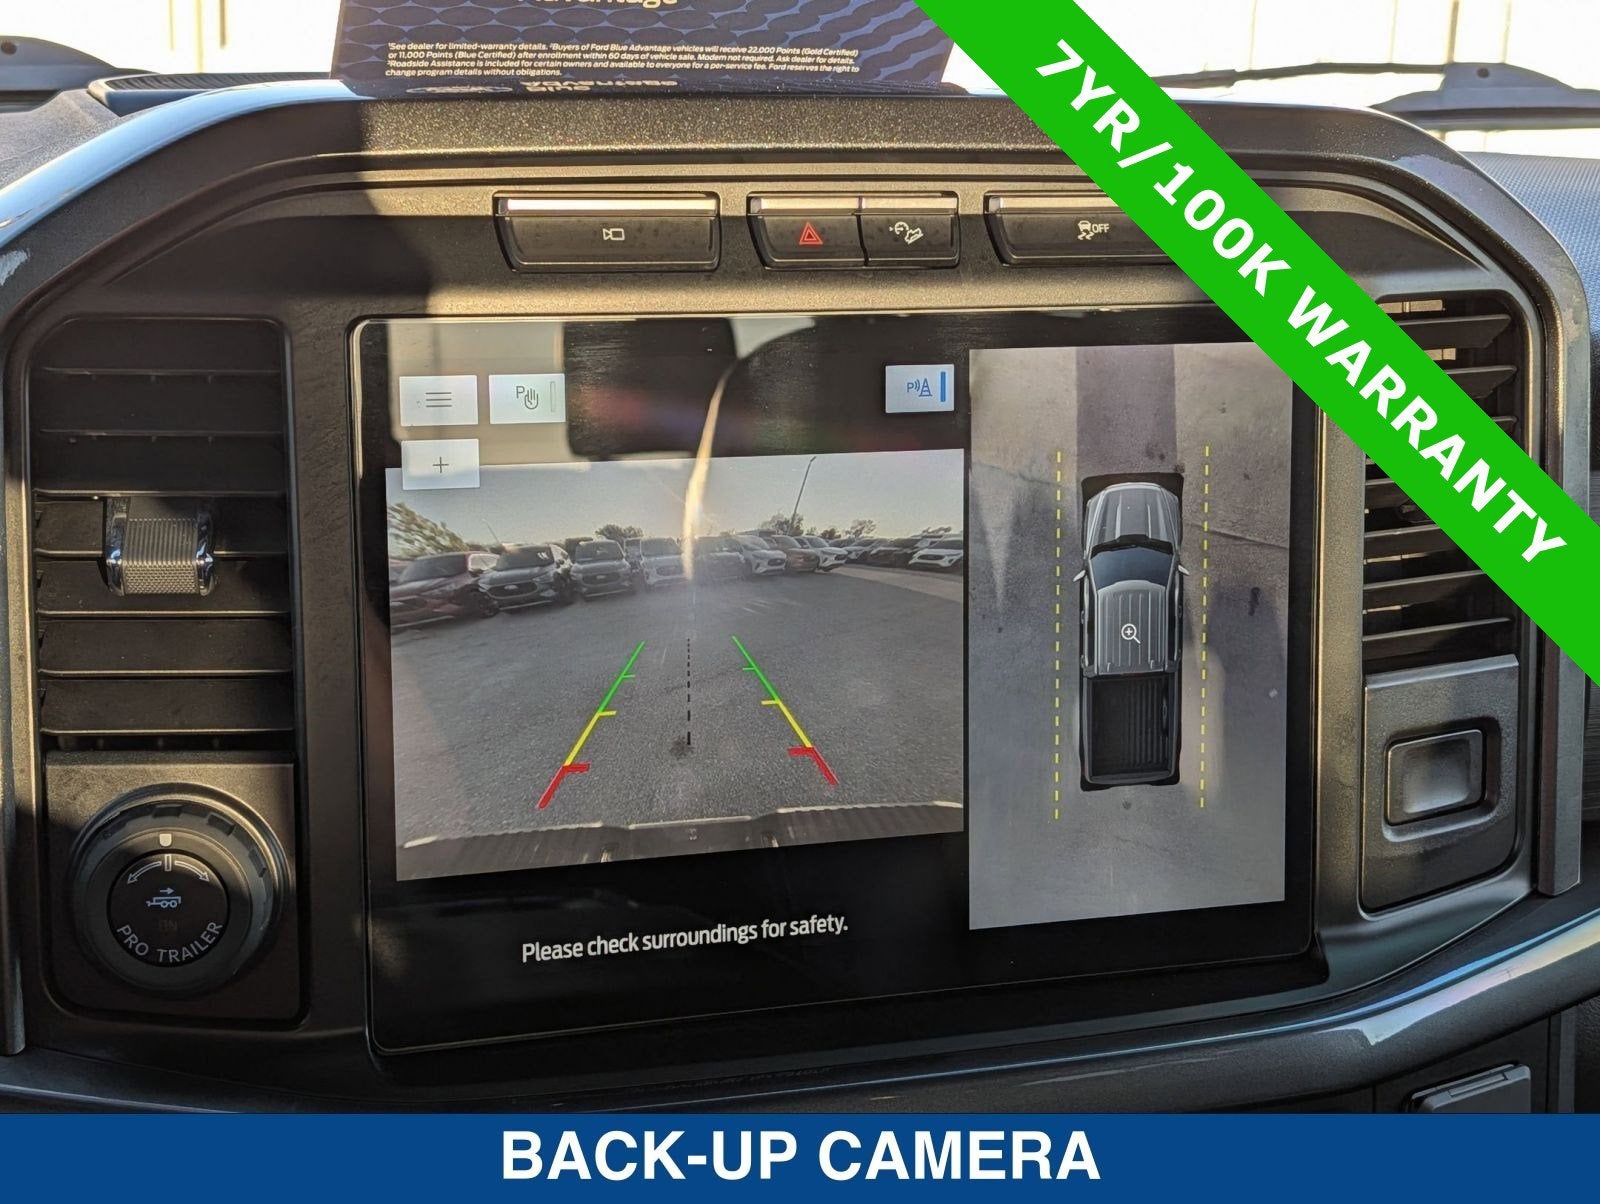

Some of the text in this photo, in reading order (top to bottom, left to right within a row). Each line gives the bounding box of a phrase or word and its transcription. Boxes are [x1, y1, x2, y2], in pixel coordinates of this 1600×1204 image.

[408, 42, 434, 50] dealer
[436, 42, 447, 50] for
[448, 42, 516, 52] limited-warranty
[581, 43, 590, 51] of
[610, 44, 628, 52] Blue
[629, 44, 672, 52] Advantage
[776, 46, 800, 54] Points
[426, 51, 453, 59] Points
[454, 51, 476, 60] (Blue
[478, 51, 516, 60] Certified)
[621, 52, 639, 60] days
[791, 55, 815, 63] dealer
[816, 56, 827, 64] for
[385, 68, 416, 77] change
[417, 69, 454, 77] program
[516, 69, 562, 77] obligations.
[820, 64, 832, 72] the
[832, 64, 850, 73] right
[1092, 223, 1110, 234] OFF
[116, 921, 224, 962] PRO TRAILER
[522, 914, 849, 963] Please check surroundings for safety.
